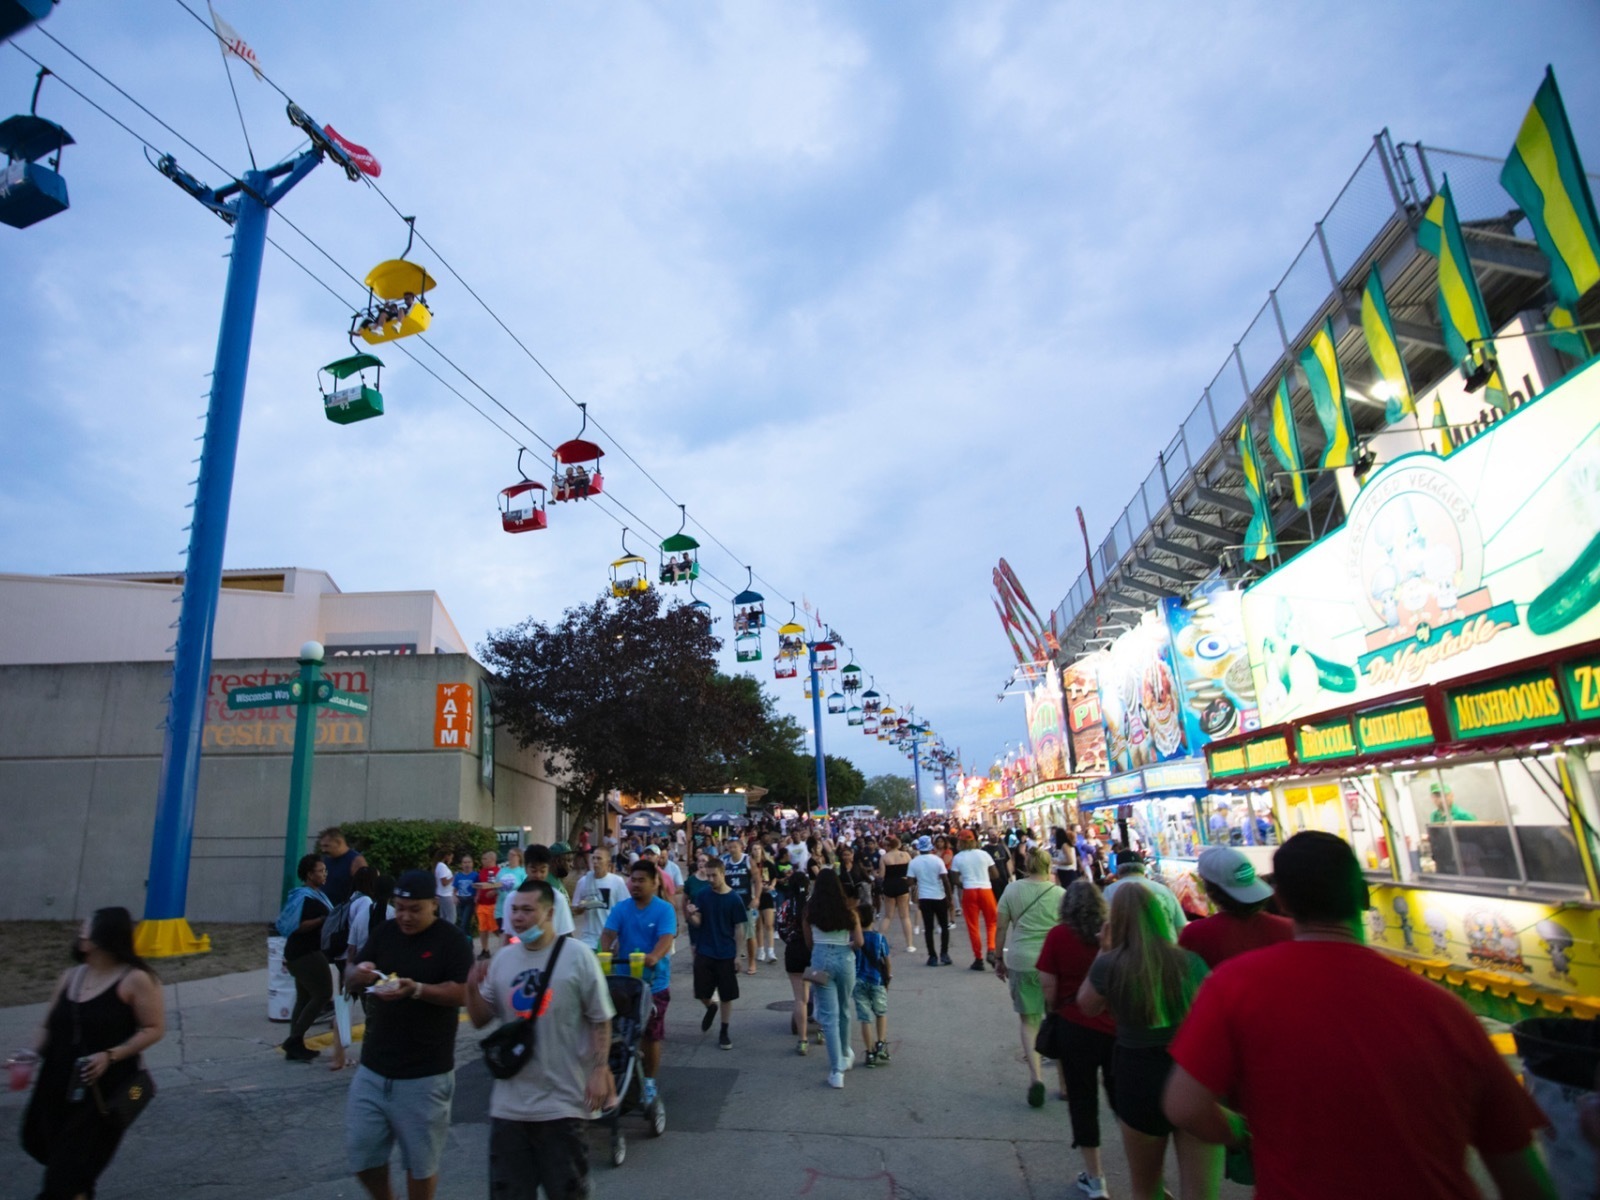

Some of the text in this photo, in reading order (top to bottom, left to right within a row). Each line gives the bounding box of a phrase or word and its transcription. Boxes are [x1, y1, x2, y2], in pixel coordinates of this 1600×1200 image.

[1409, 472, 1470, 524] VEGGIES
[1394, 614, 1512, 686] Vegetable
[207, 668, 370, 697] restrm
[235, 689, 290, 703] Wisconsin Way
[1455, 677, 1560, 731] MUSHROOMS
[441, 699, 458, 744] ATM
[1360, 706, 1433, 747] CAULIFLOWER
